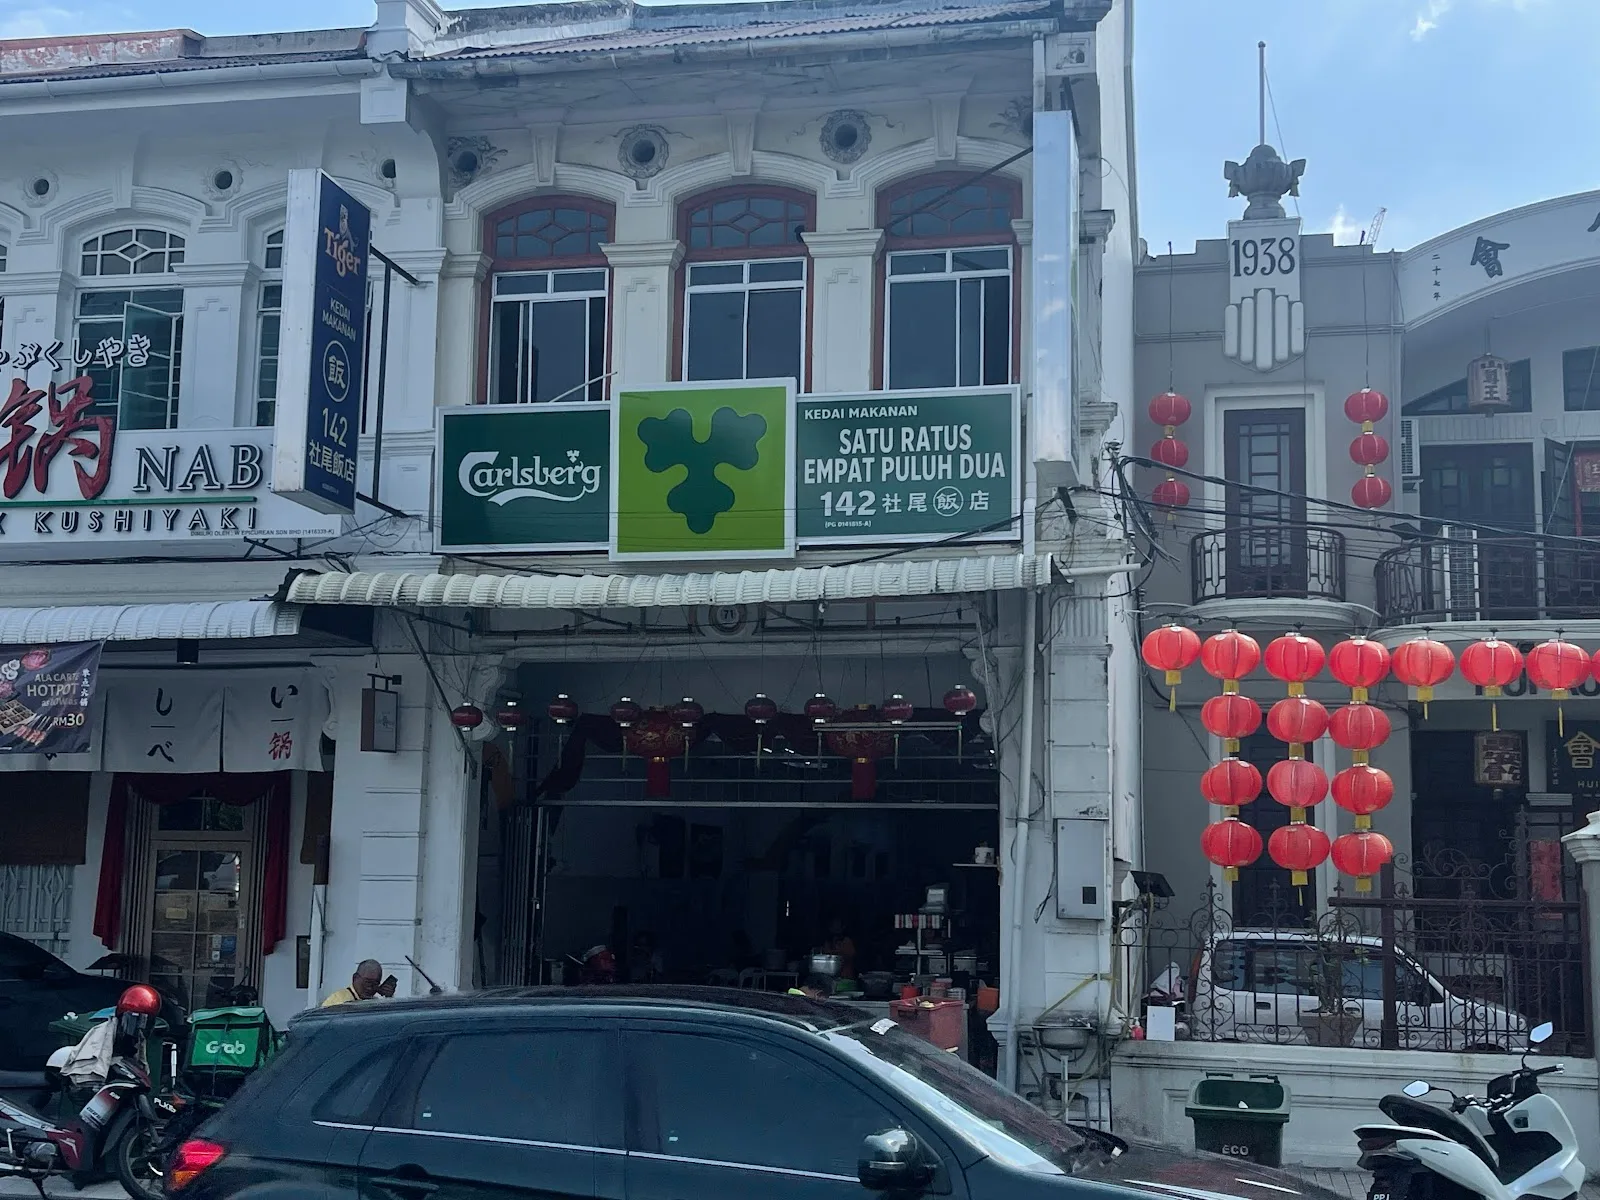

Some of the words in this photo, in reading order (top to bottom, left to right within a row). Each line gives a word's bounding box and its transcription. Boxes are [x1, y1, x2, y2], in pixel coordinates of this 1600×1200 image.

[324, 227, 361, 278] Tiger
[1231, 236, 1296, 277] 1938
[322, 309, 356, 342] MAKANAN
[330, 297, 351, 322] KEDAI
[328, 354, 346, 390] 飯
[322, 407, 348, 449] 142
[804, 409, 845, 420] KEDAI
[849, 405, 918, 418] MAKANAN
[839, 427, 894, 455] SATU
[901, 423, 972, 452] RATUS
[132, 443, 274, 493] NAB
[309, 438, 356, 485] 社尾飯店
[458, 451, 602, 497] Carlsberg
[804, 456, 875, 484] EMPAT
[881, 454, 952, 482] PULUH
[959, 452, 1006, 479] DUA
[820, 490, 877, 517] 142
[34, 506, 258, 535] KUSHIYAKI
[27, 683, 79, 697] HOTPOT
[34, 673, 52, 683] ALA
[53, 712, 85, 727] RM30
[205, 1040, 246, 1055] Grab
[1222, 1145, 1249, 1156] ECO
